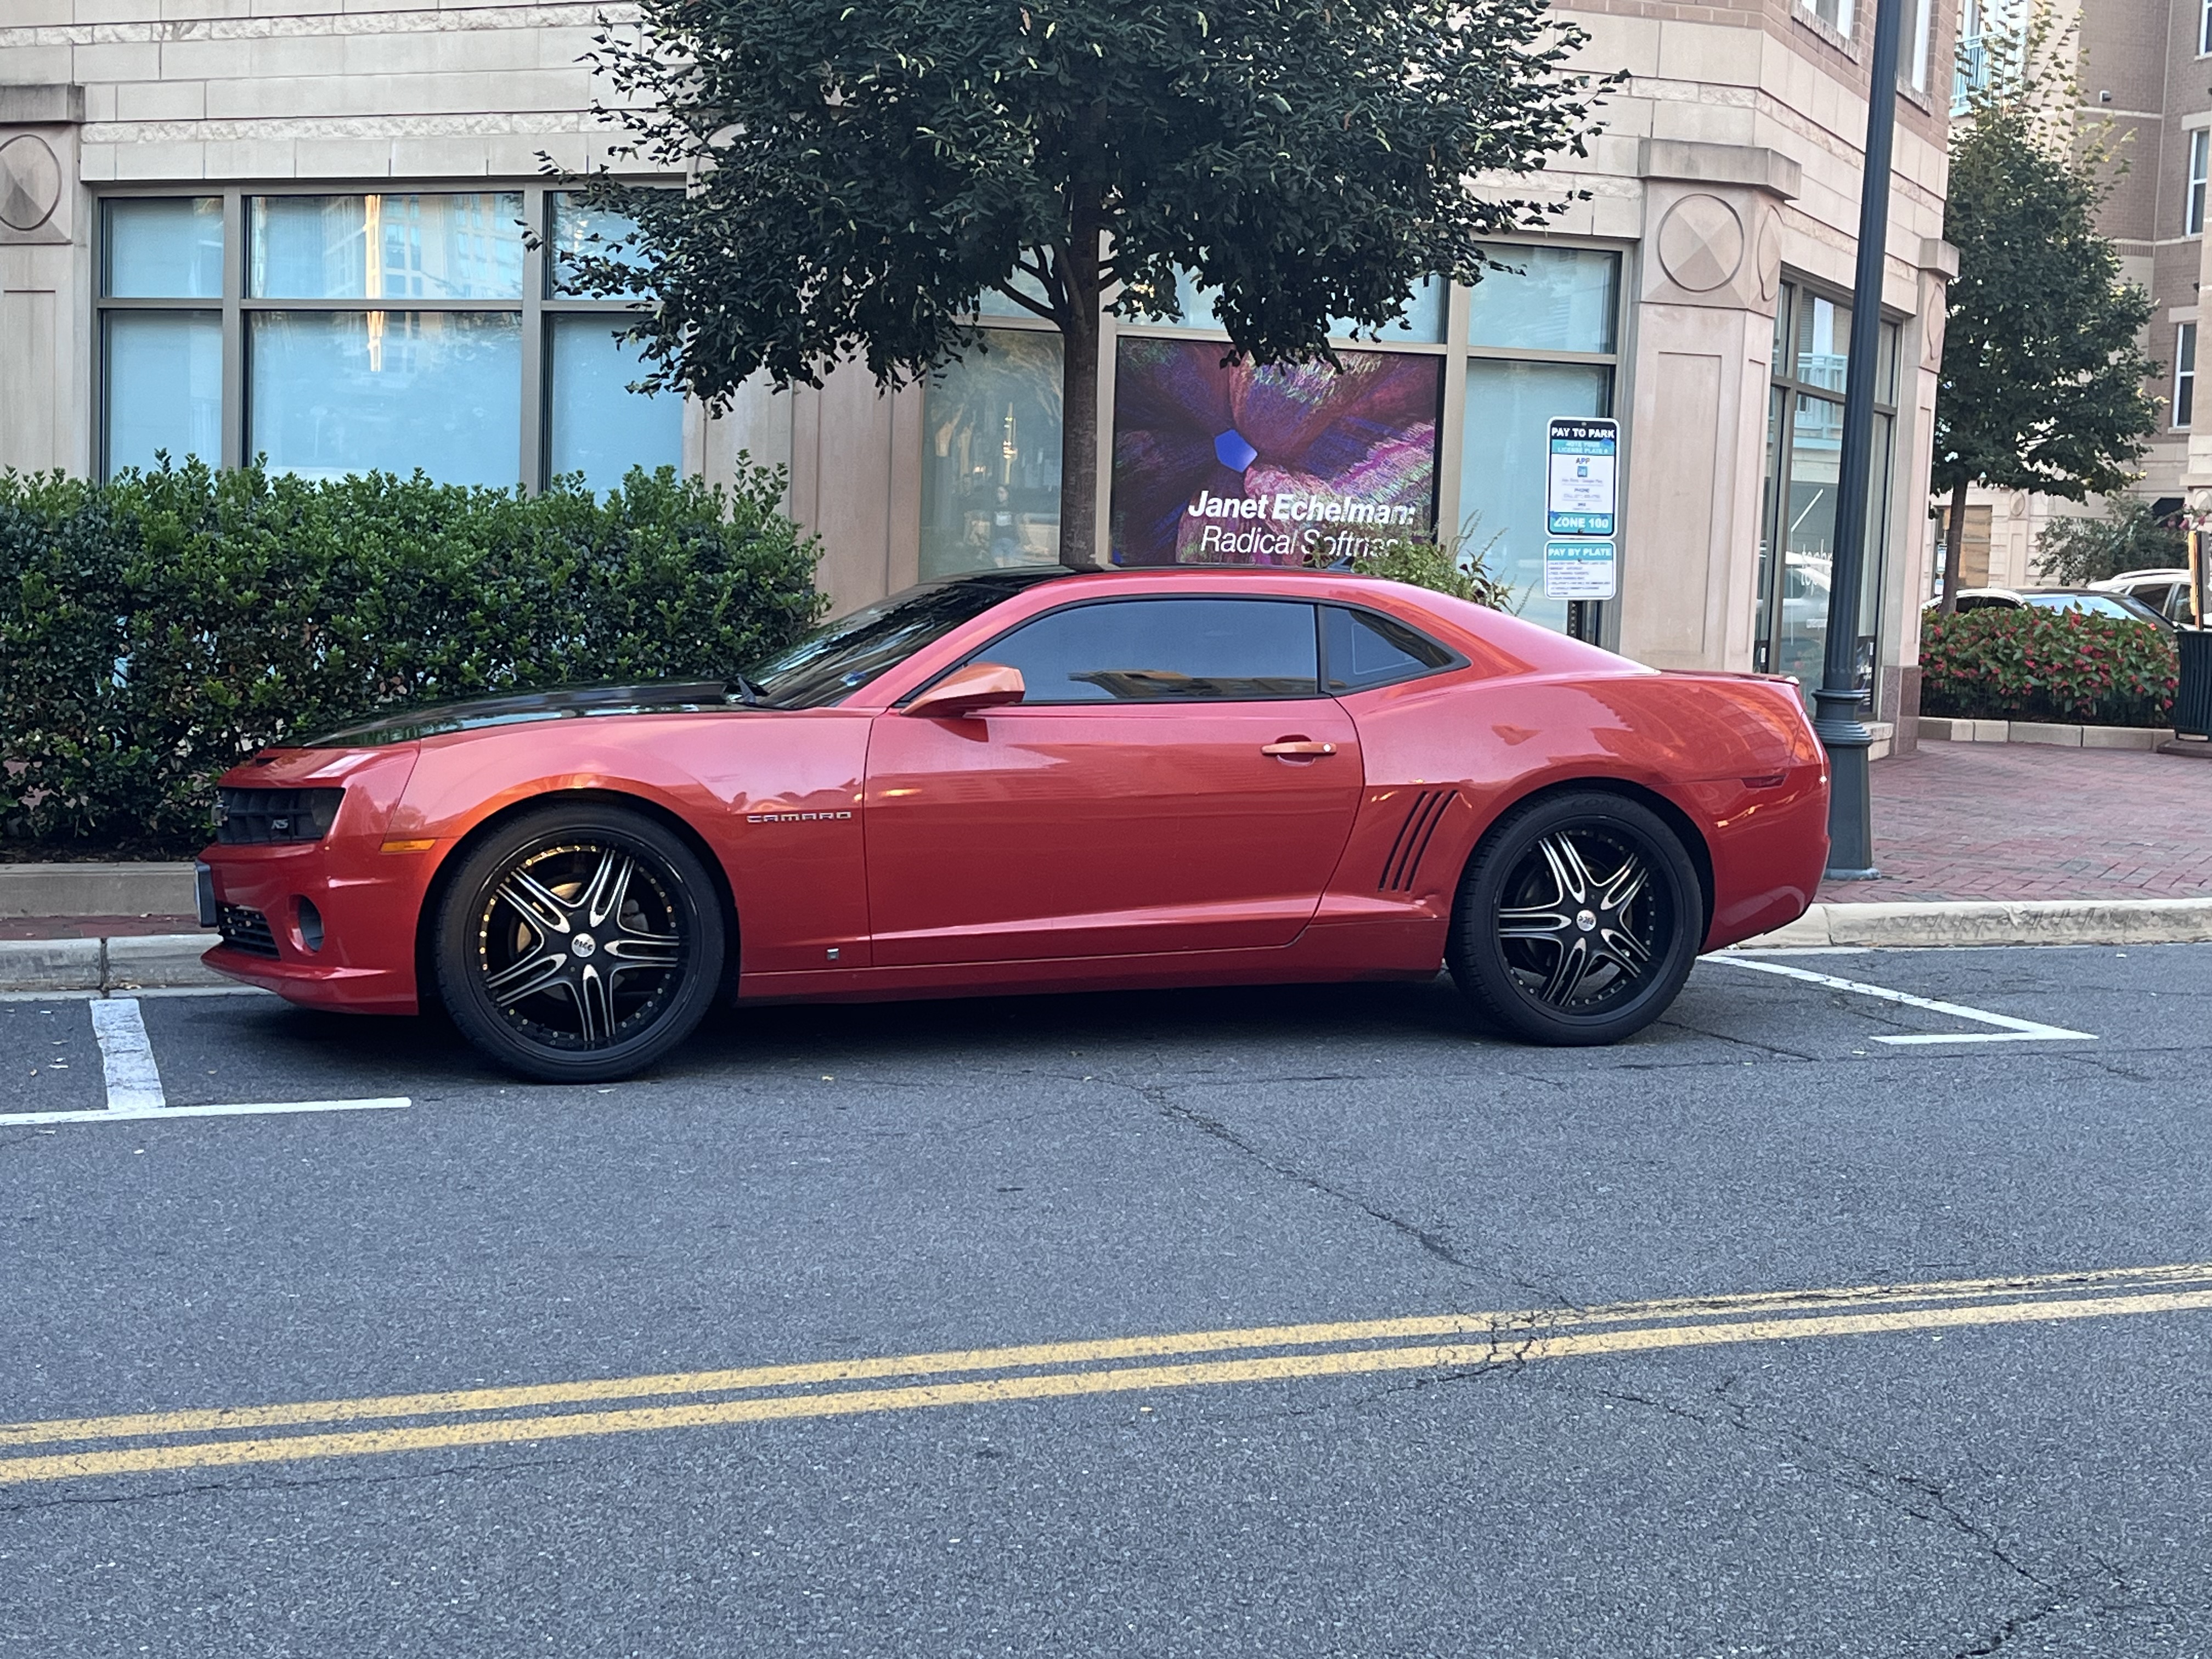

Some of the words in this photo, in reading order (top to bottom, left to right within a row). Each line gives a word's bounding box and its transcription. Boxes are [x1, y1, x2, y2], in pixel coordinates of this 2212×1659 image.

[1551, 427, 1570, 437] PAY
[1572, 428, 1586, 437] TO
[1588, 428, 1615, 438] PARK
[1188, 490, 1269, 520] Janet
[1272, 493, 1415, 525] Echelman:
[1554, 517, 1585, 528] ZONE
[1589, 518, 1609, 528] 100
[1200, 525, 1298, 555] Radical
[1548, 548, 1566, 556] PAY
[1568, 548, 1581, 556] BY
[1583, 548, 1612, 556] PLATE
[746, 811, 851, 823] CAMARO
[271, 819, 289, 830] RS
